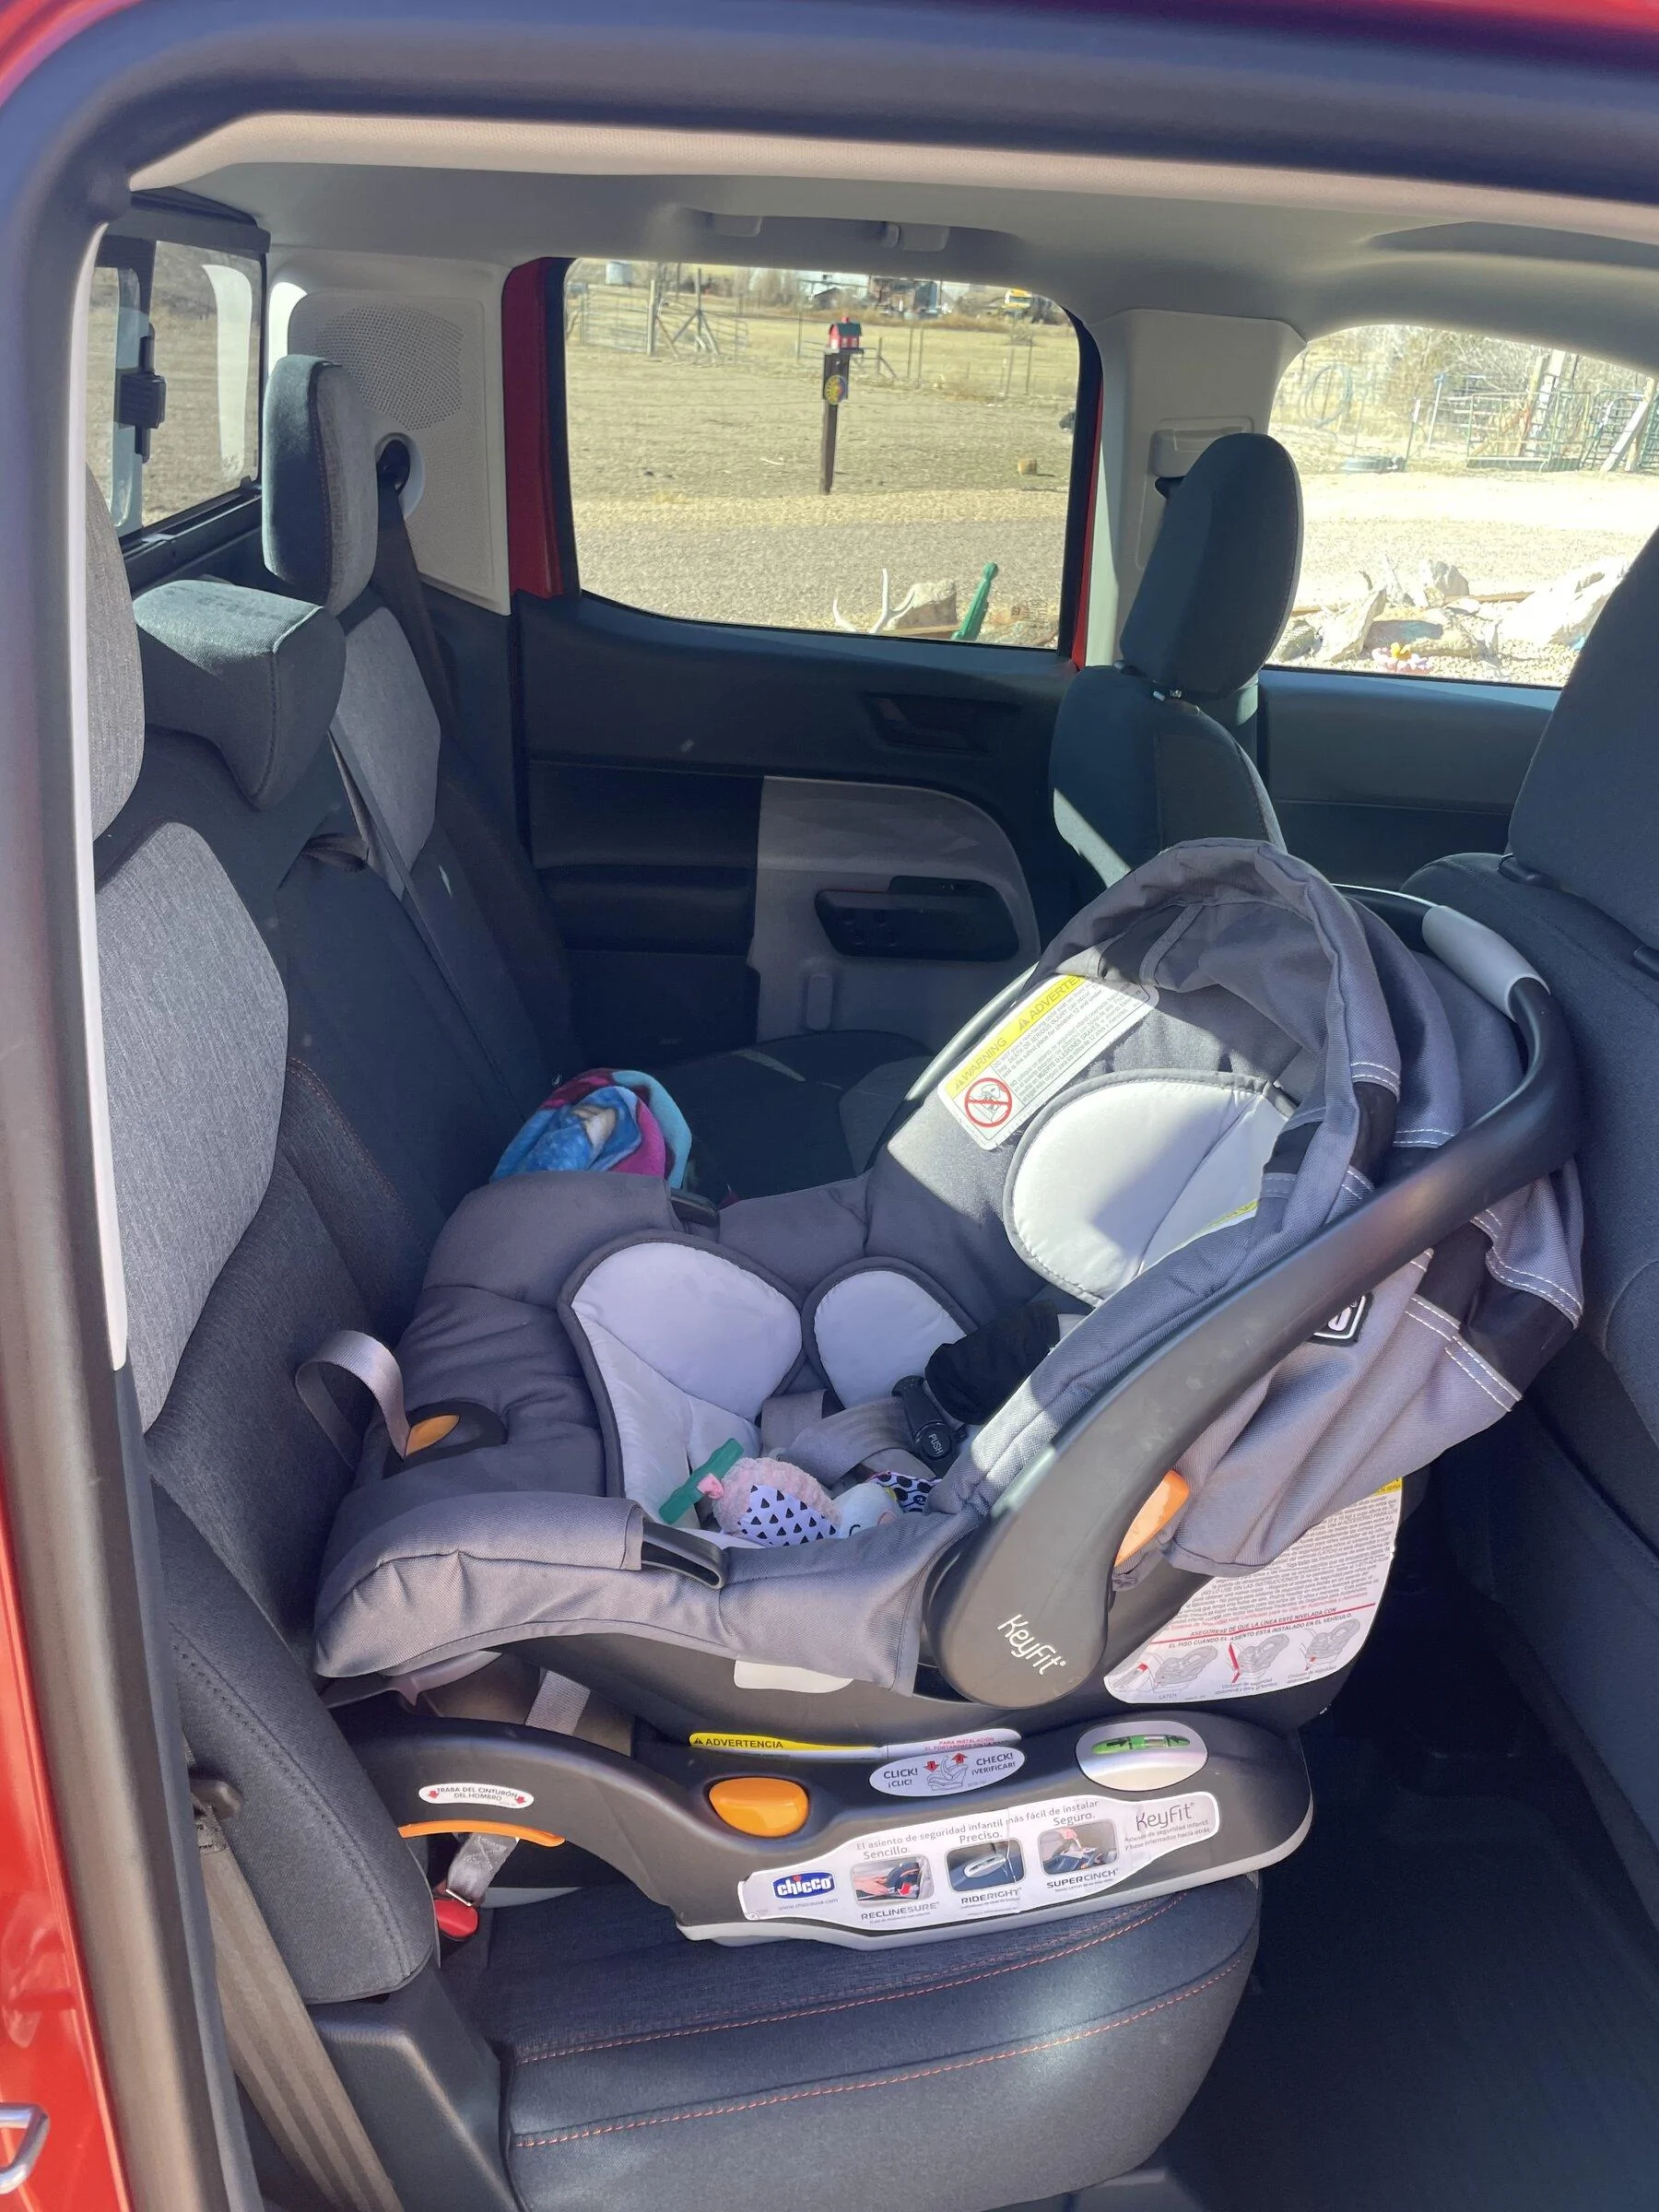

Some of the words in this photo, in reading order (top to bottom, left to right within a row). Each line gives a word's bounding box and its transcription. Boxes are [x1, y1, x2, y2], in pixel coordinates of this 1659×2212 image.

[959, 1036, 1007, 1080] WARNING
[1029, 975, 1080, 1020] ADVERTE
[929, 1433, 944, 1454] PUSH
[996, 1614, 1062, 1676] KeyFit
[1193, 1635, 1218, 1646] CUANDO
[705, 1738, 783, 1748] ADVERTENCIA
[976, 1752, 1014, 1766] CHECK!
[883, 1768, 918, 1780] CLICK!
[478, 1788, 518, 1798] CINTURÓN
[856, 1842, 866, 1851] El
[868, 1838, 903, 1849] asiento
[905, 1834, 918, 1842] de
[919, 1825, 966, 1841] seguridad
[969, 1819, 1004, 1831] infantil
[1006, 1816, 1025, 1825] más
[1026, 1811, 1047, 1821] fácil
[1049, 1807, 1060, 1816] de
[1063, 1800, 1100, 1813] instalar
[1053, 1812, 1096, 1827] Seguro.
[1135, 1804, 1192, 1831] KeyFit
[959, 1831, 1003, 1843] Preciso.
[777, 1877, 831, 1895] chicco
[1046, 1870, 1115, 1889] SUPERCINCH
